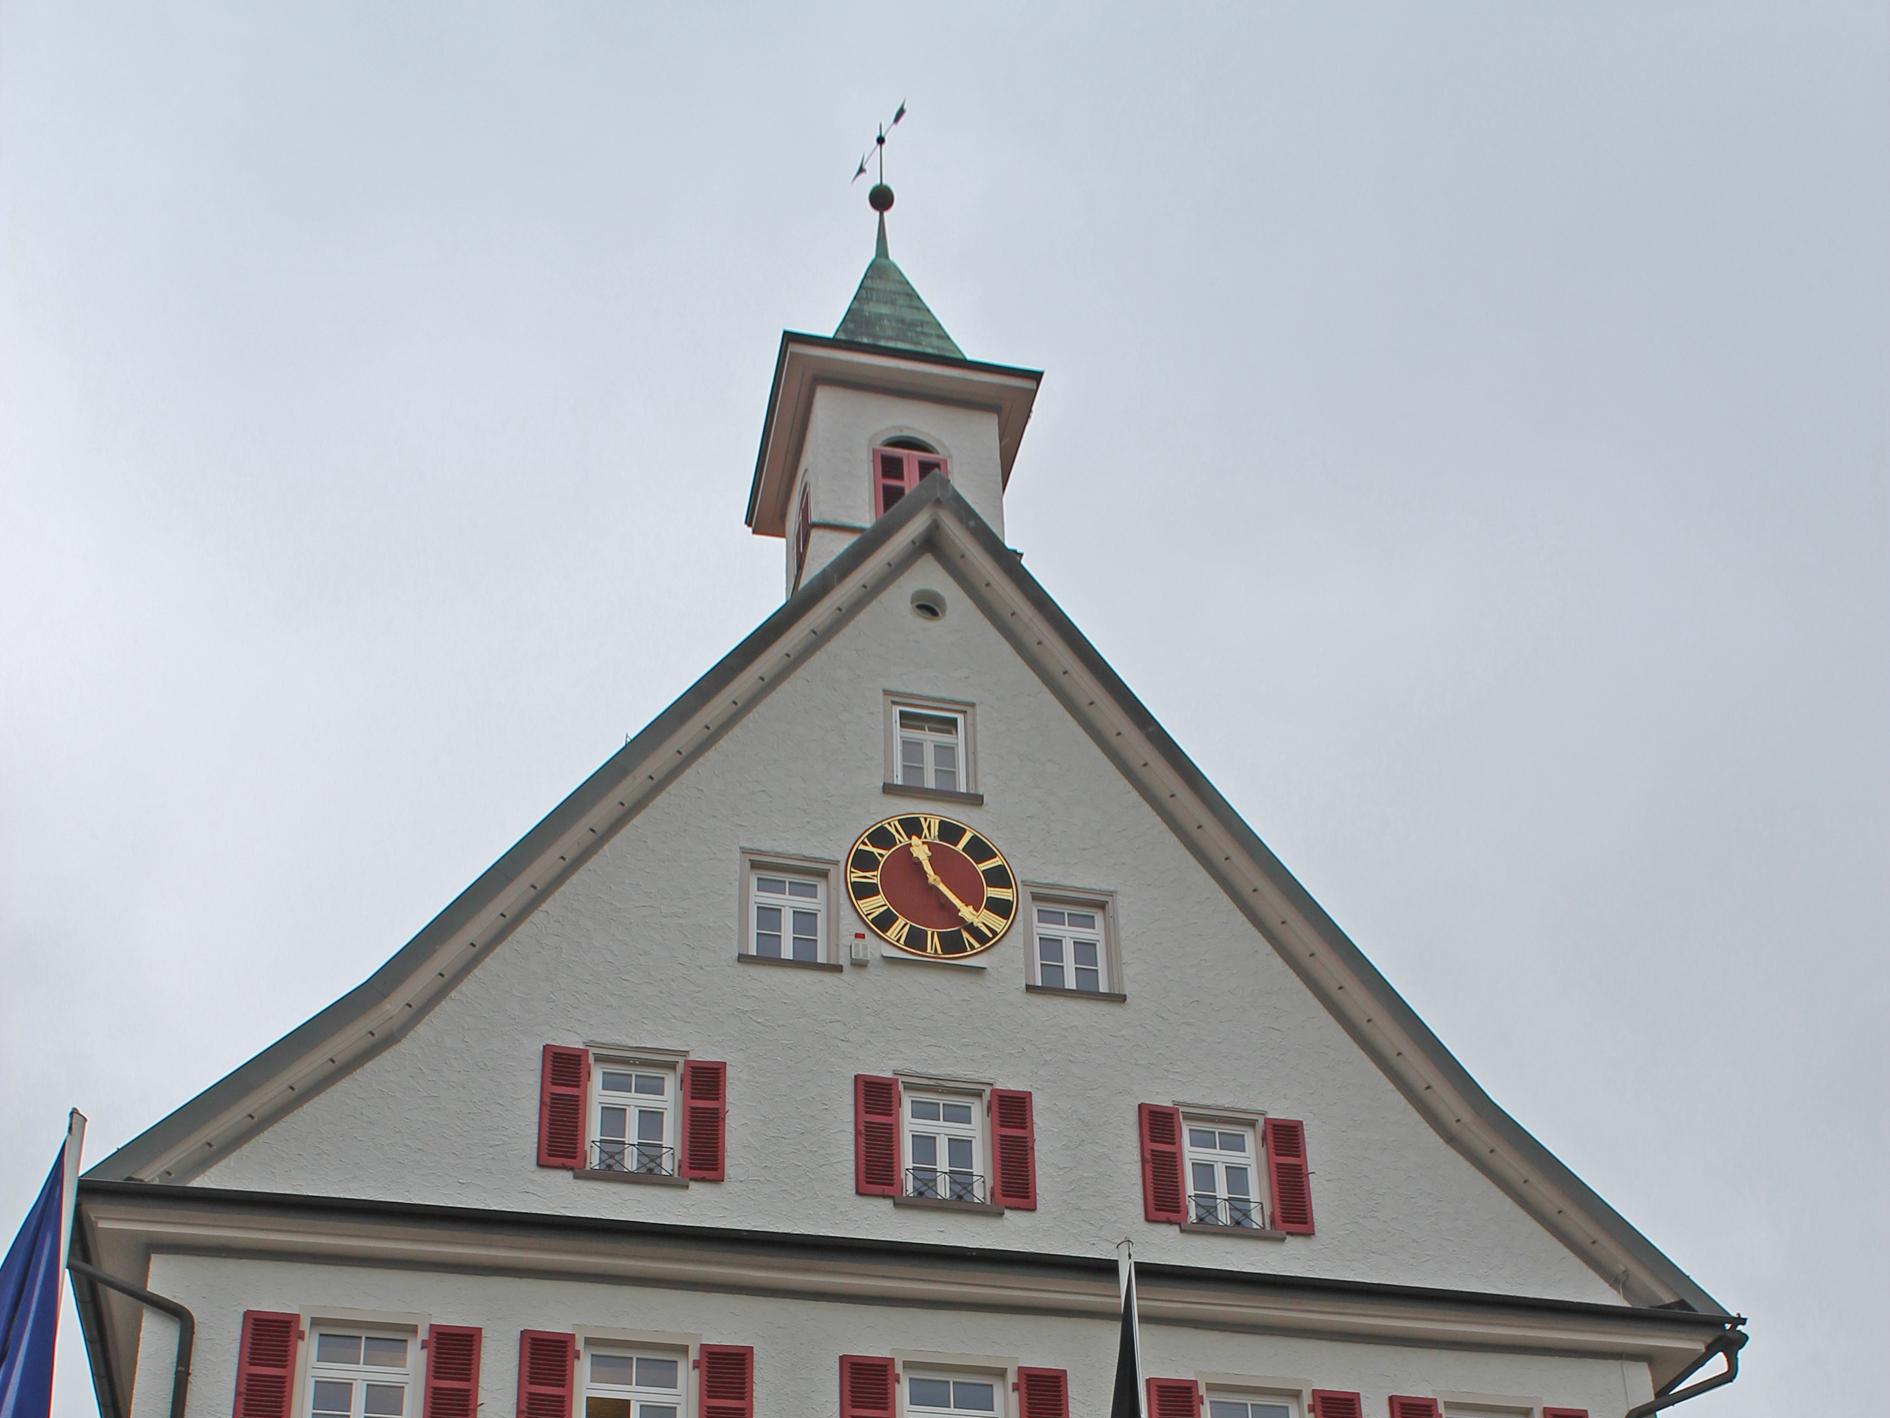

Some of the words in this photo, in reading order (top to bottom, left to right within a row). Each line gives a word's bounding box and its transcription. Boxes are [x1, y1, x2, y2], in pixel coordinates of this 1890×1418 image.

[883, 820, 909, 845] XI
[920, 817, 940, 841] XII
[957, 829, 974, 850] I
[858, 838, 889, 861] X
[851, 867, 878, 883] IX
[978, 856, 1003, 871] II
[986, 887, 1013, 901] III
[857, 895, 888, 921] VIII
[886, 917, 911, 945] VII
[926, 930, 943, 955] VI
[961, 928, 981, 952] V
